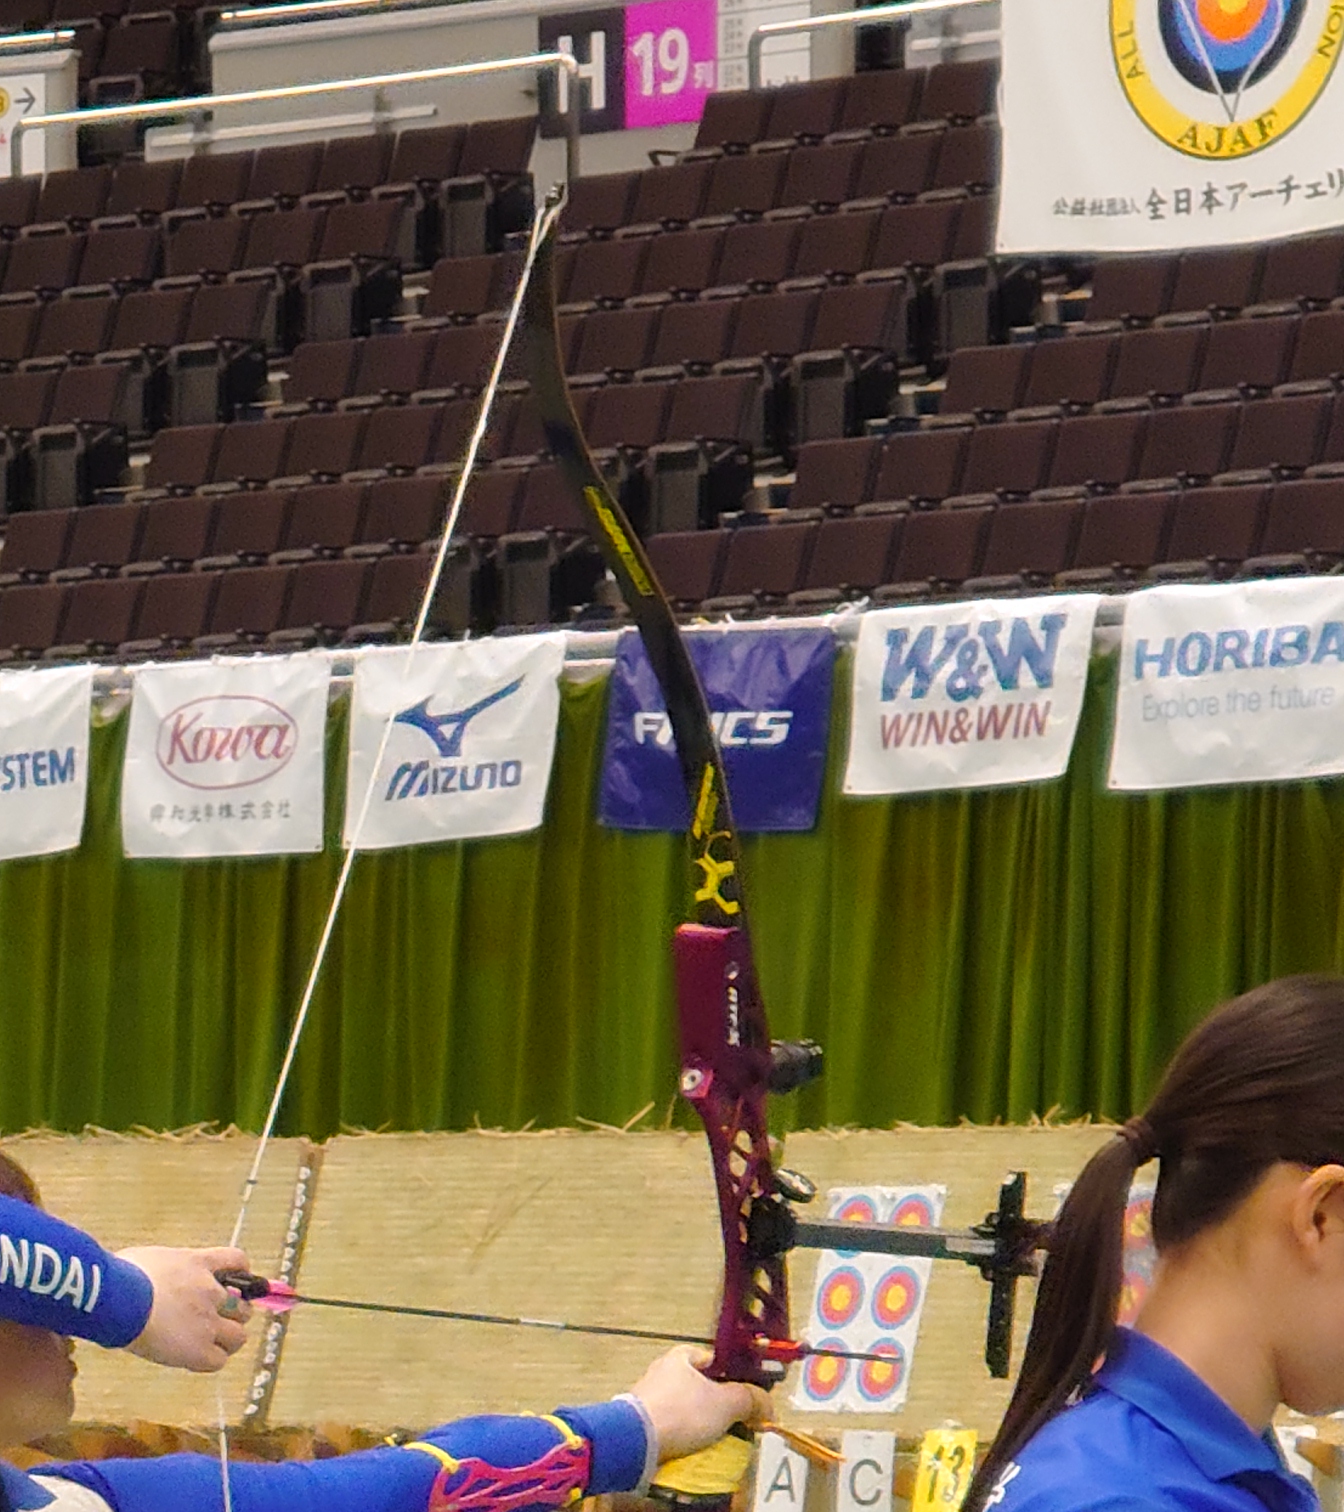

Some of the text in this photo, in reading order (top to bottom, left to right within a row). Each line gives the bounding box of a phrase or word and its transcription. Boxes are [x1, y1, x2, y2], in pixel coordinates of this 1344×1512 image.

[558, 30, 606, 114] H
[1117, 20, 1145, 80] ALL
[1177, 109, 1280, 154] AJAF
[880, 613, 1068, 703] W&W
[1134, 621, 1344, 681] HORIBA
[880, 700, 1052, 750] WIN&WIN
[1142, 684, 1335, 723] Explore the future
[166, 711, 291, 766] Kowa
[384, 759, 522, 801] MIZUNO
[764, 1455, 796, 1504] A
[848, 1458, 883, 1506] C
